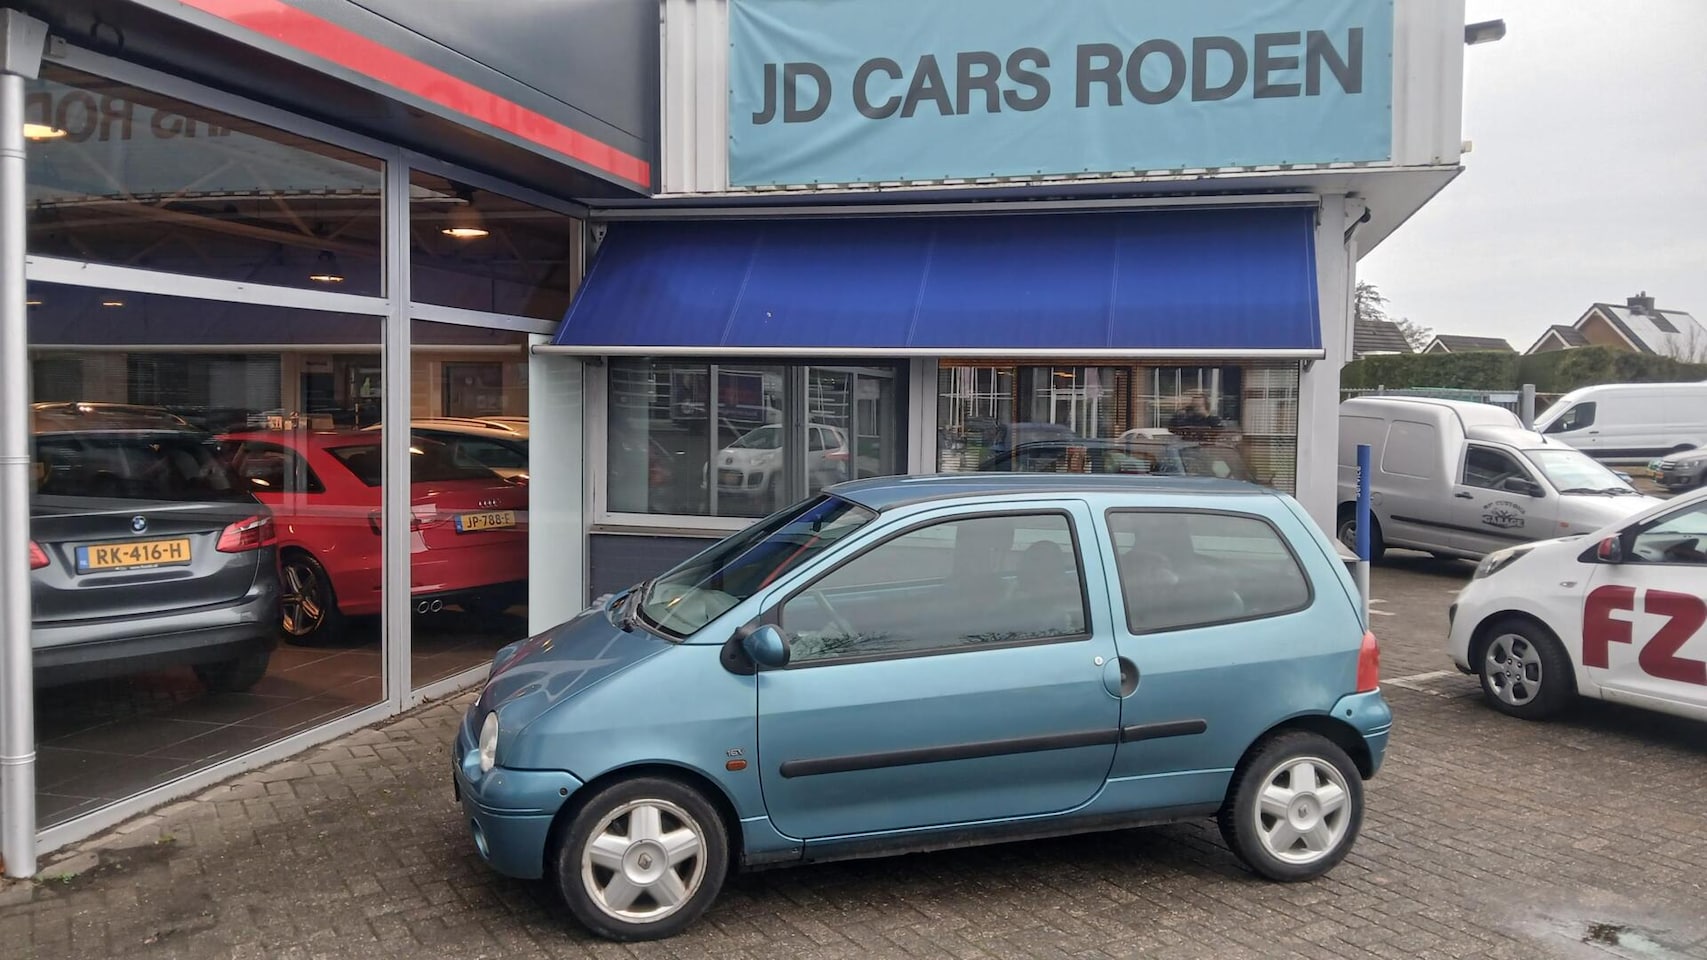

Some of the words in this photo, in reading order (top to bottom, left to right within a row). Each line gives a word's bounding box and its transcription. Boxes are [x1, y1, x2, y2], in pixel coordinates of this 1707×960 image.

[752, 62, 832, 125] JD
[851, 47, 1051, 119] CARS
[1075, 27, 1364, 109] RODEN
[96, 542, 182, 566] RK-416-H
[1582, 584, 1707, 686] FZ
